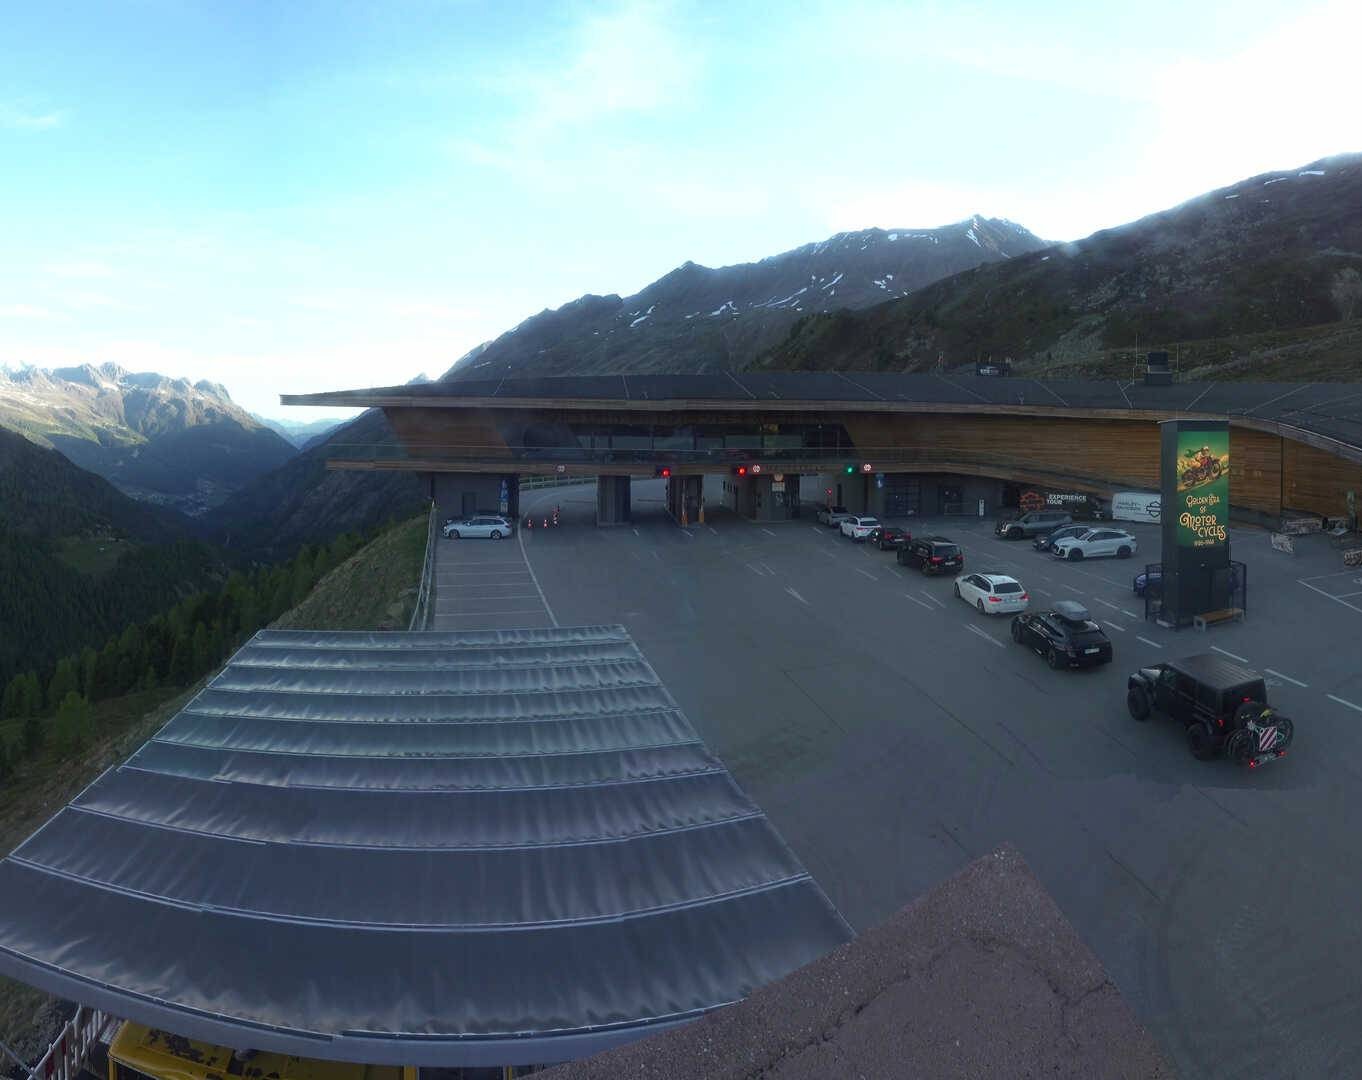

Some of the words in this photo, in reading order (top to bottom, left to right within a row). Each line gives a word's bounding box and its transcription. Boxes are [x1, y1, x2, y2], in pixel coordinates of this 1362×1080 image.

[1048, 494, 1087, 503] EXPERIENCE
[1180, 512, 1217, 531] MOTOR
[1198, 525, 1226, 541] CYCLES
